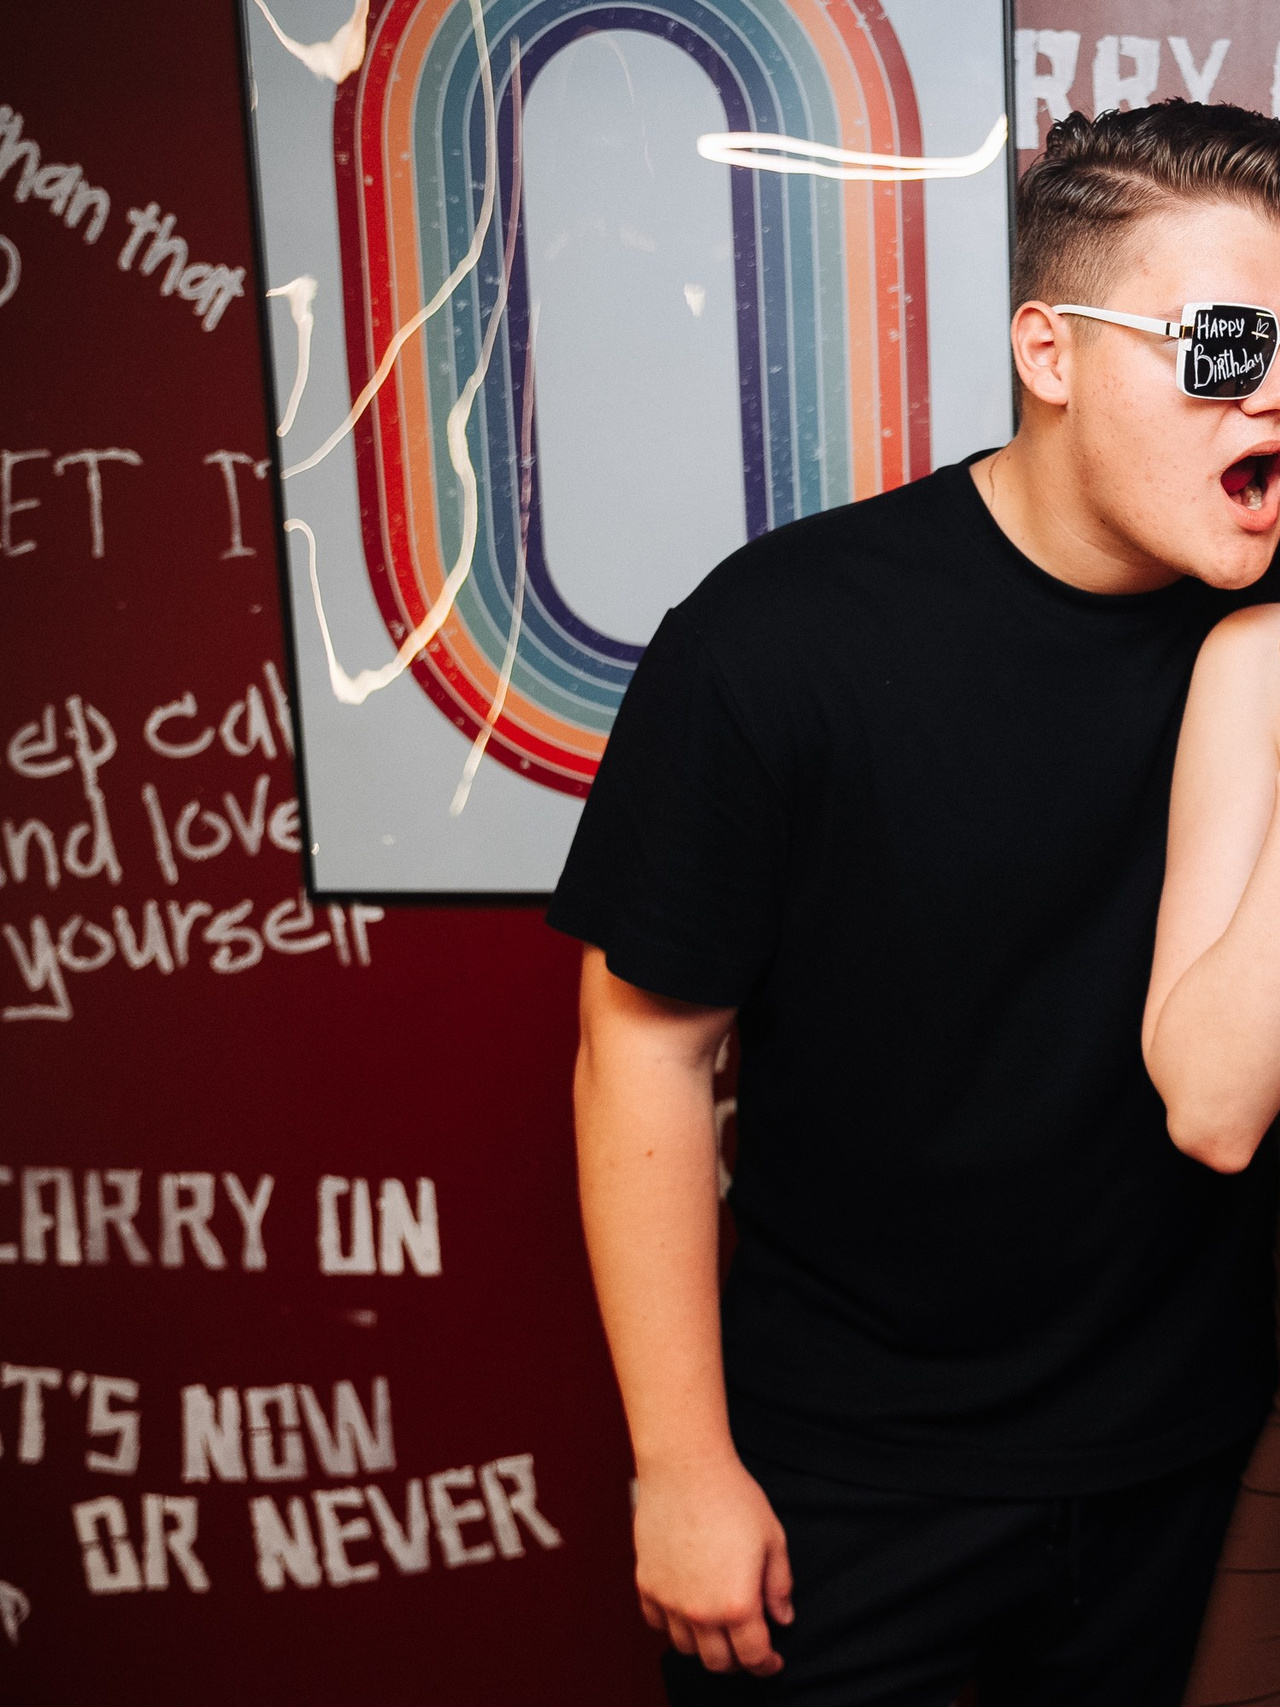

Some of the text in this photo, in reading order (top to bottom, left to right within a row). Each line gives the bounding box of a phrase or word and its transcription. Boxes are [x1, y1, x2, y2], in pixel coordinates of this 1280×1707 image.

[117, 201, 246, 332] that
[1197, 313, 1245, 340] HAPPY
[0, 773, 301, 889] nd love
[317, 1174, 443, 1276] ON
[0, 1362, 397, 1483] T'S NOW
[72, 1453, 563, 1595] OR NEVER
